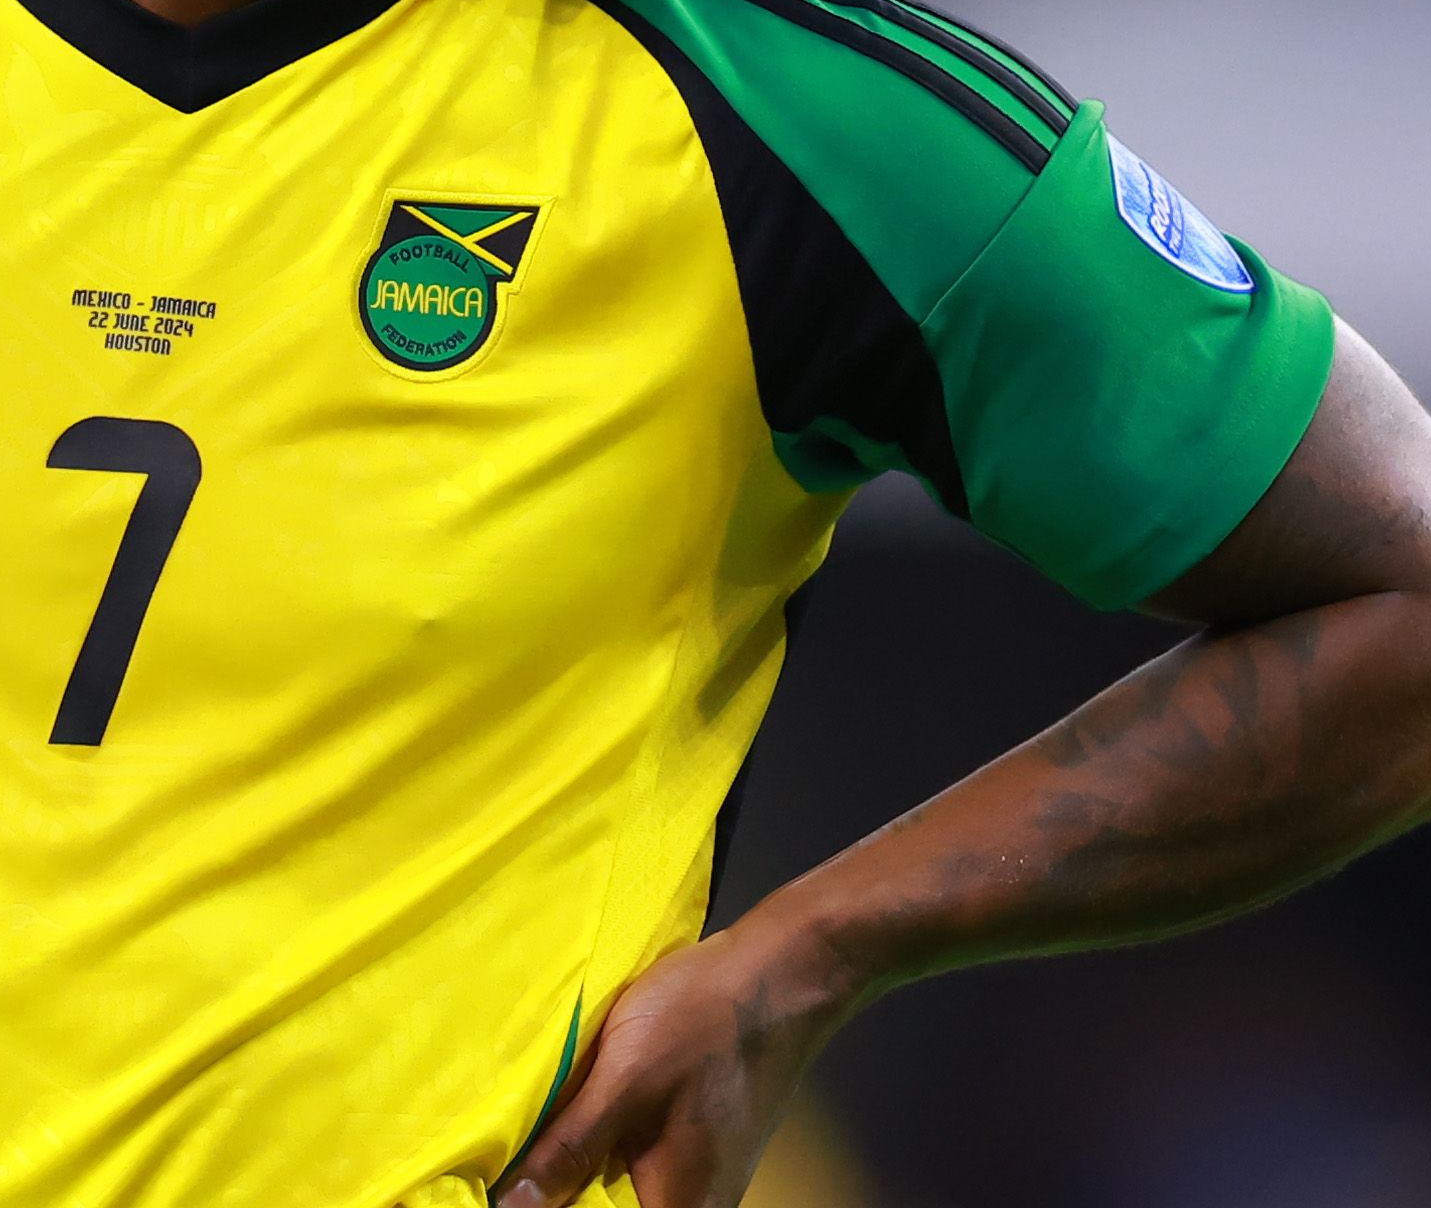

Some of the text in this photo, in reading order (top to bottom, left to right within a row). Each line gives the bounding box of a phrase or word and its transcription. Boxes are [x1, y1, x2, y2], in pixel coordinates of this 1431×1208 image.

[389, 244, 470, 274] FOOTBALL
[72, 289, 131, 310] MEXICO
[150, 296, 217, 319] JAMAICA
[370, 279, 483, 318] JAMAICA
[88, 311, 194, 337] 22 JUNE 2024
[104, 333, 171, 355] HOUSTON
[381, 324, 467, 356] FEDERATION
[46, 416, 202, 746] 7
